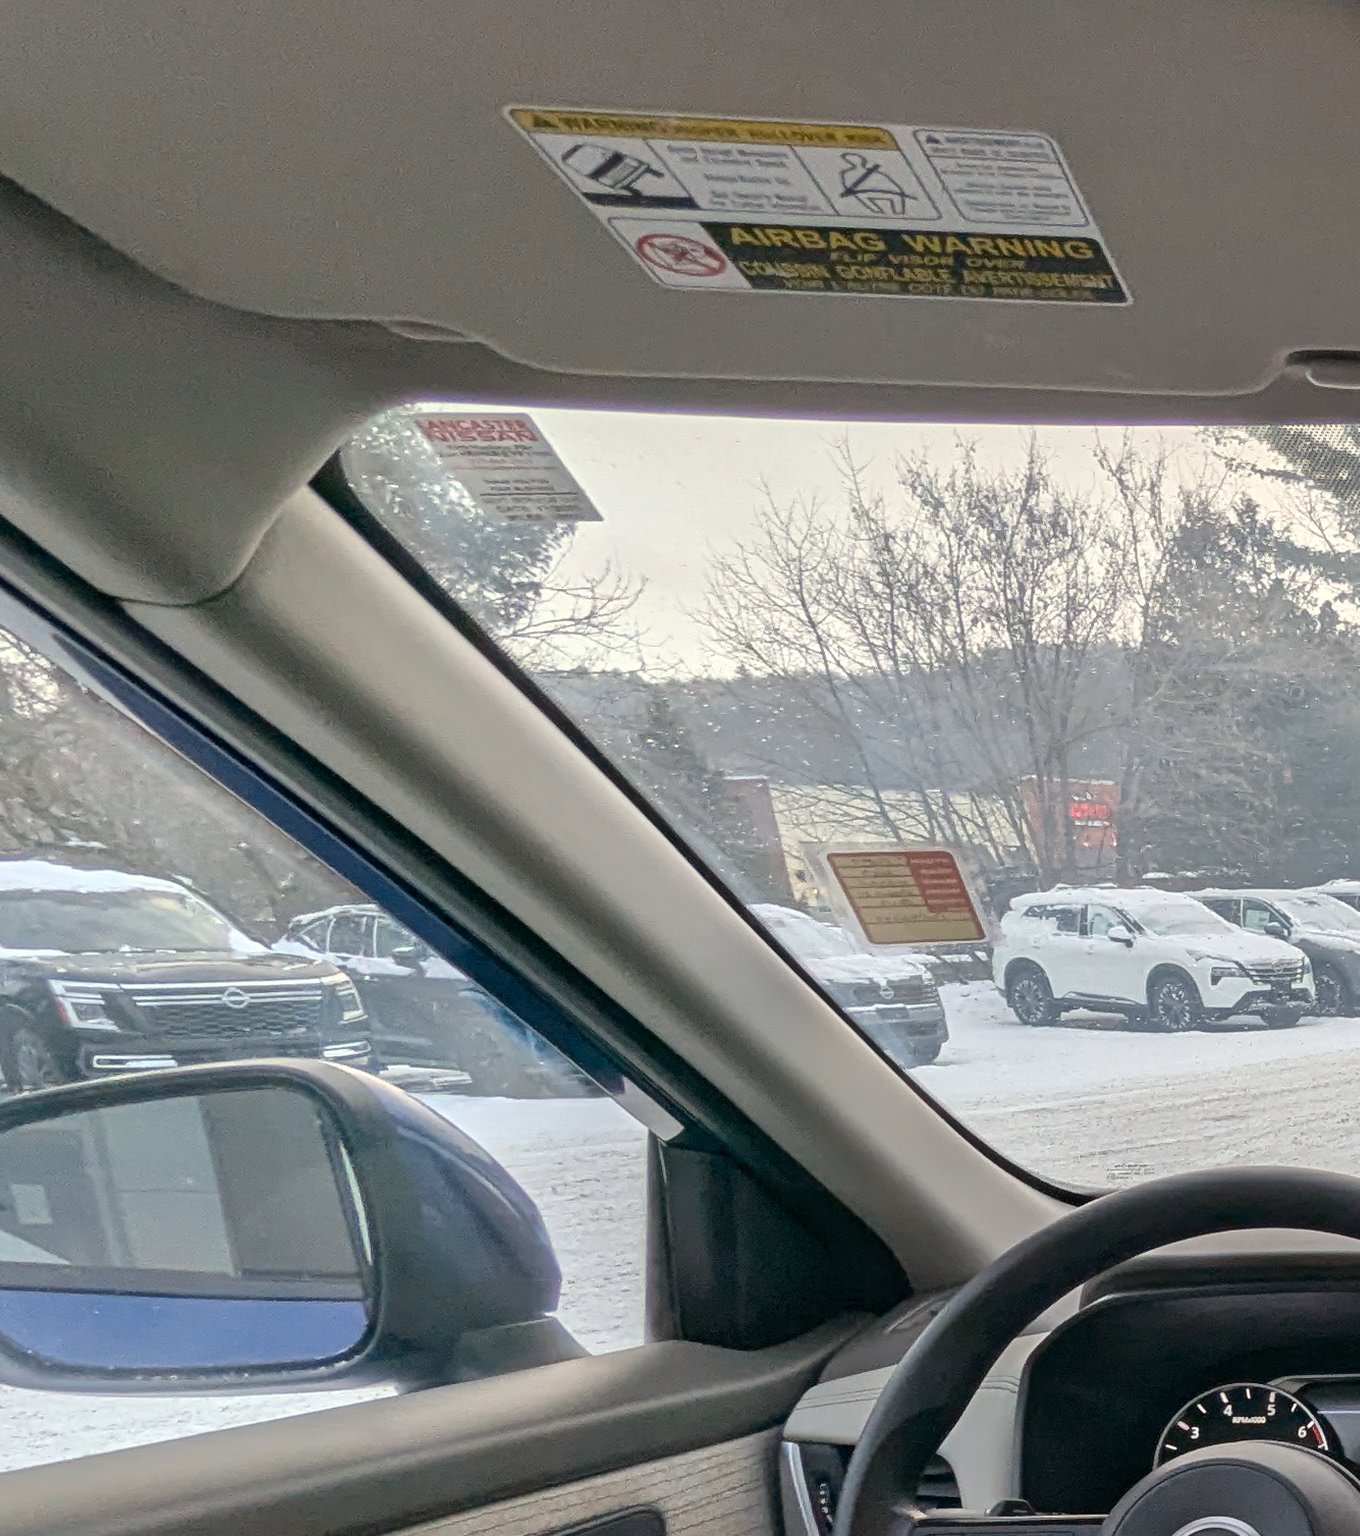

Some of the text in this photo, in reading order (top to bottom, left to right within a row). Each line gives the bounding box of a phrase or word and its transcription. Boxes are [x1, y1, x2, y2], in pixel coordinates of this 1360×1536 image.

[730, 227, 1095, 260] AIRBAG WARNING
[1222, 1404, 1233, 1417] 4
[1267, 1404, 1276, 1416] 5
[1190, 1426, 1200, 1440] 3
[1297, 1426, 1308, 1439] 6
